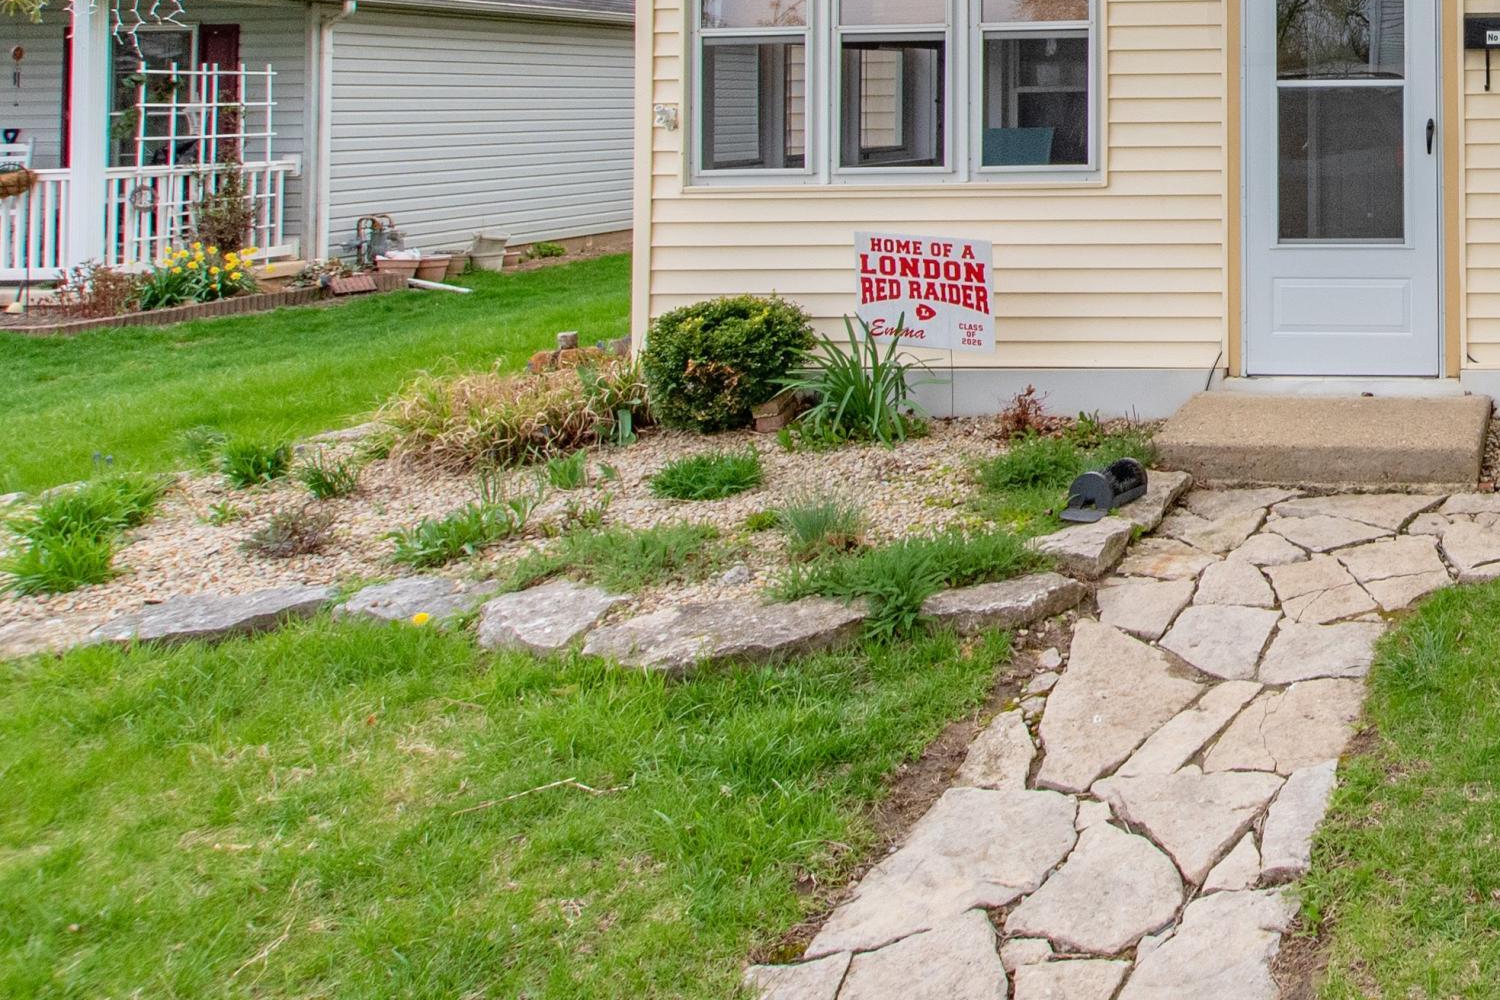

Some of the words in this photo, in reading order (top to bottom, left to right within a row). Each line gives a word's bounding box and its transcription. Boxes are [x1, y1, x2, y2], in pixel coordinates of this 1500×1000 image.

[870, 237, 922, 255] HOME
[930, 243, 953, 257] OF
[961, 245, 975, 259] A
[860, 254, 985, 283] LONDON
[861, 277, 901, 304] RED
[908, 280, 990, 315] RAIDER
[959, 323, 983, 331] CLASS
